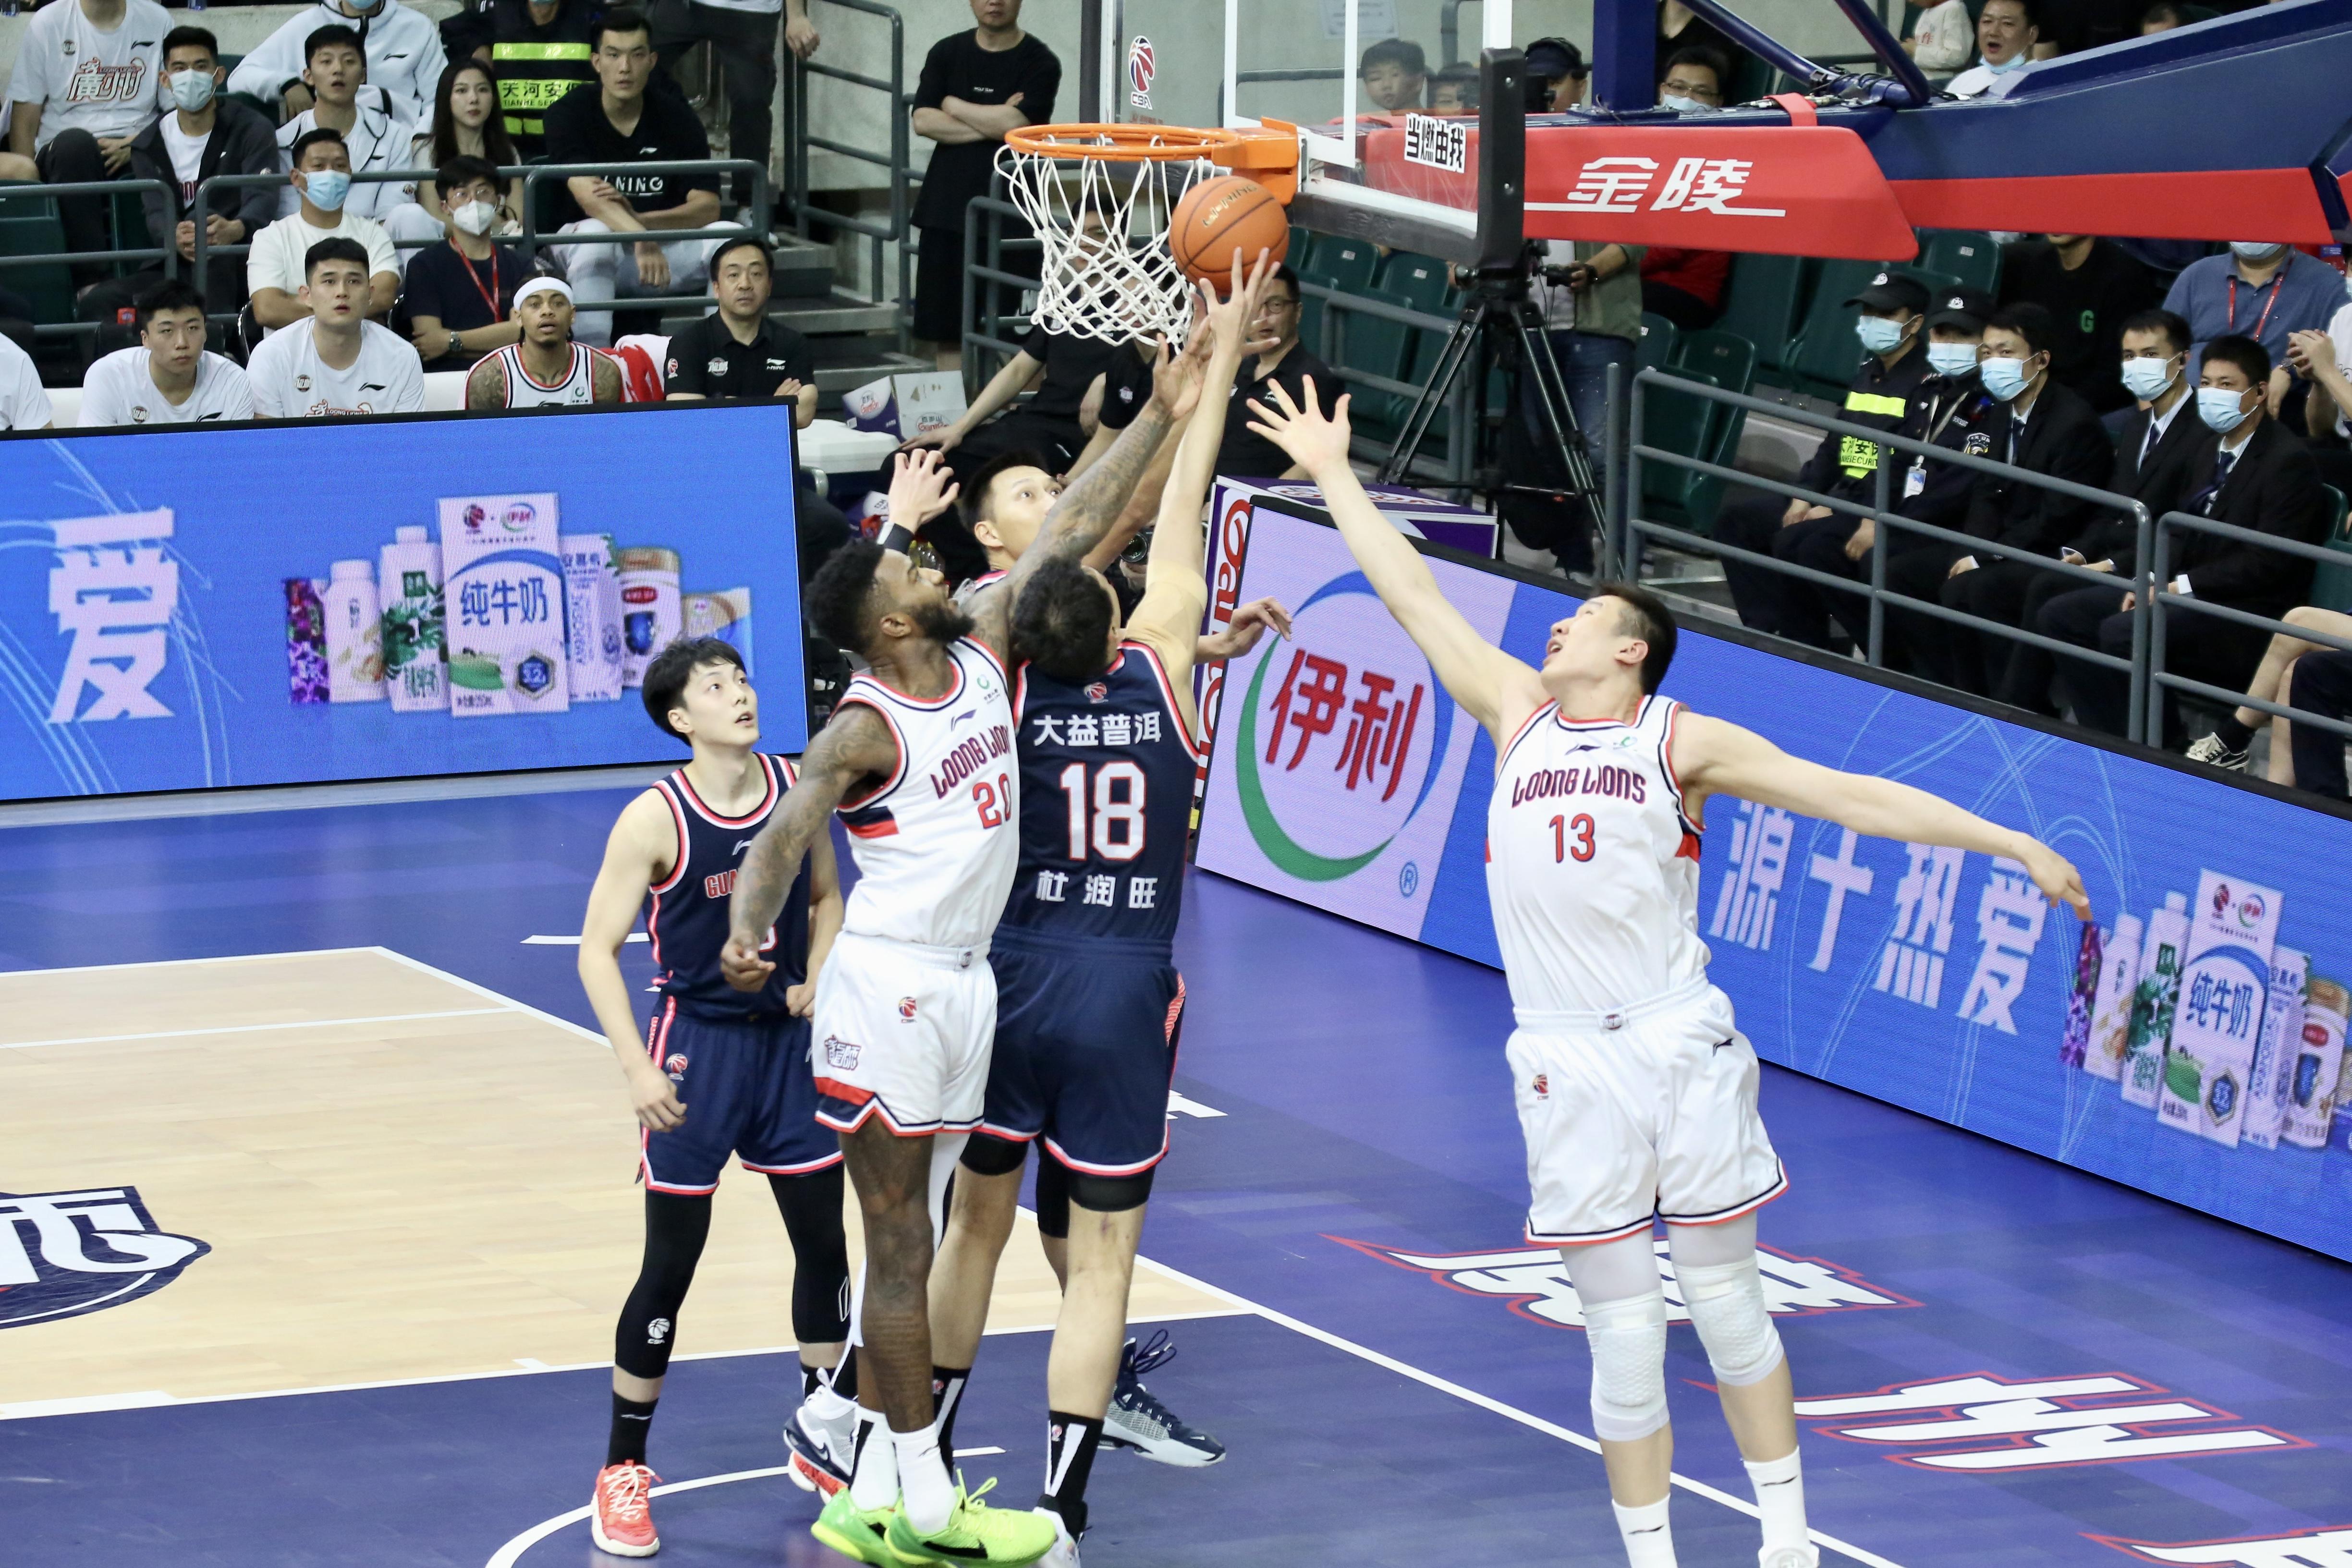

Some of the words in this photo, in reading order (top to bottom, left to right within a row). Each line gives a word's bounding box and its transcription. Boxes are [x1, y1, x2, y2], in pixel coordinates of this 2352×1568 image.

[1131, 92, 1153, 110] CBA
[1406, 117, 1463, 169] 当燃由我
[1544, 157, 1786, 217] 金陵
[2081, 309, 2094, 333] G
[49, 505, 178, 724] 爱
[460, 578, 548, 626] 纯牛奶
[1033, 711, 1162, 747] 大益普洱
[1266, 647, 1424, 802] 伊利
[930, 737, 988, 799] LOONG
[1512, 768, 1580, 809] LOONG
[1581, 764, 1647, 805] LIONS
[972, 773, 1011, 829] 20
[1060, 761, 1147, 861] 18
[1548, 813, 1596, 863] 13
[1036, 870, 1158, 909] 杜润旺
[1708, 799, 2049, 1036] 源十热爱
[2186, 971, 2254, 1039] 纯牛奶
